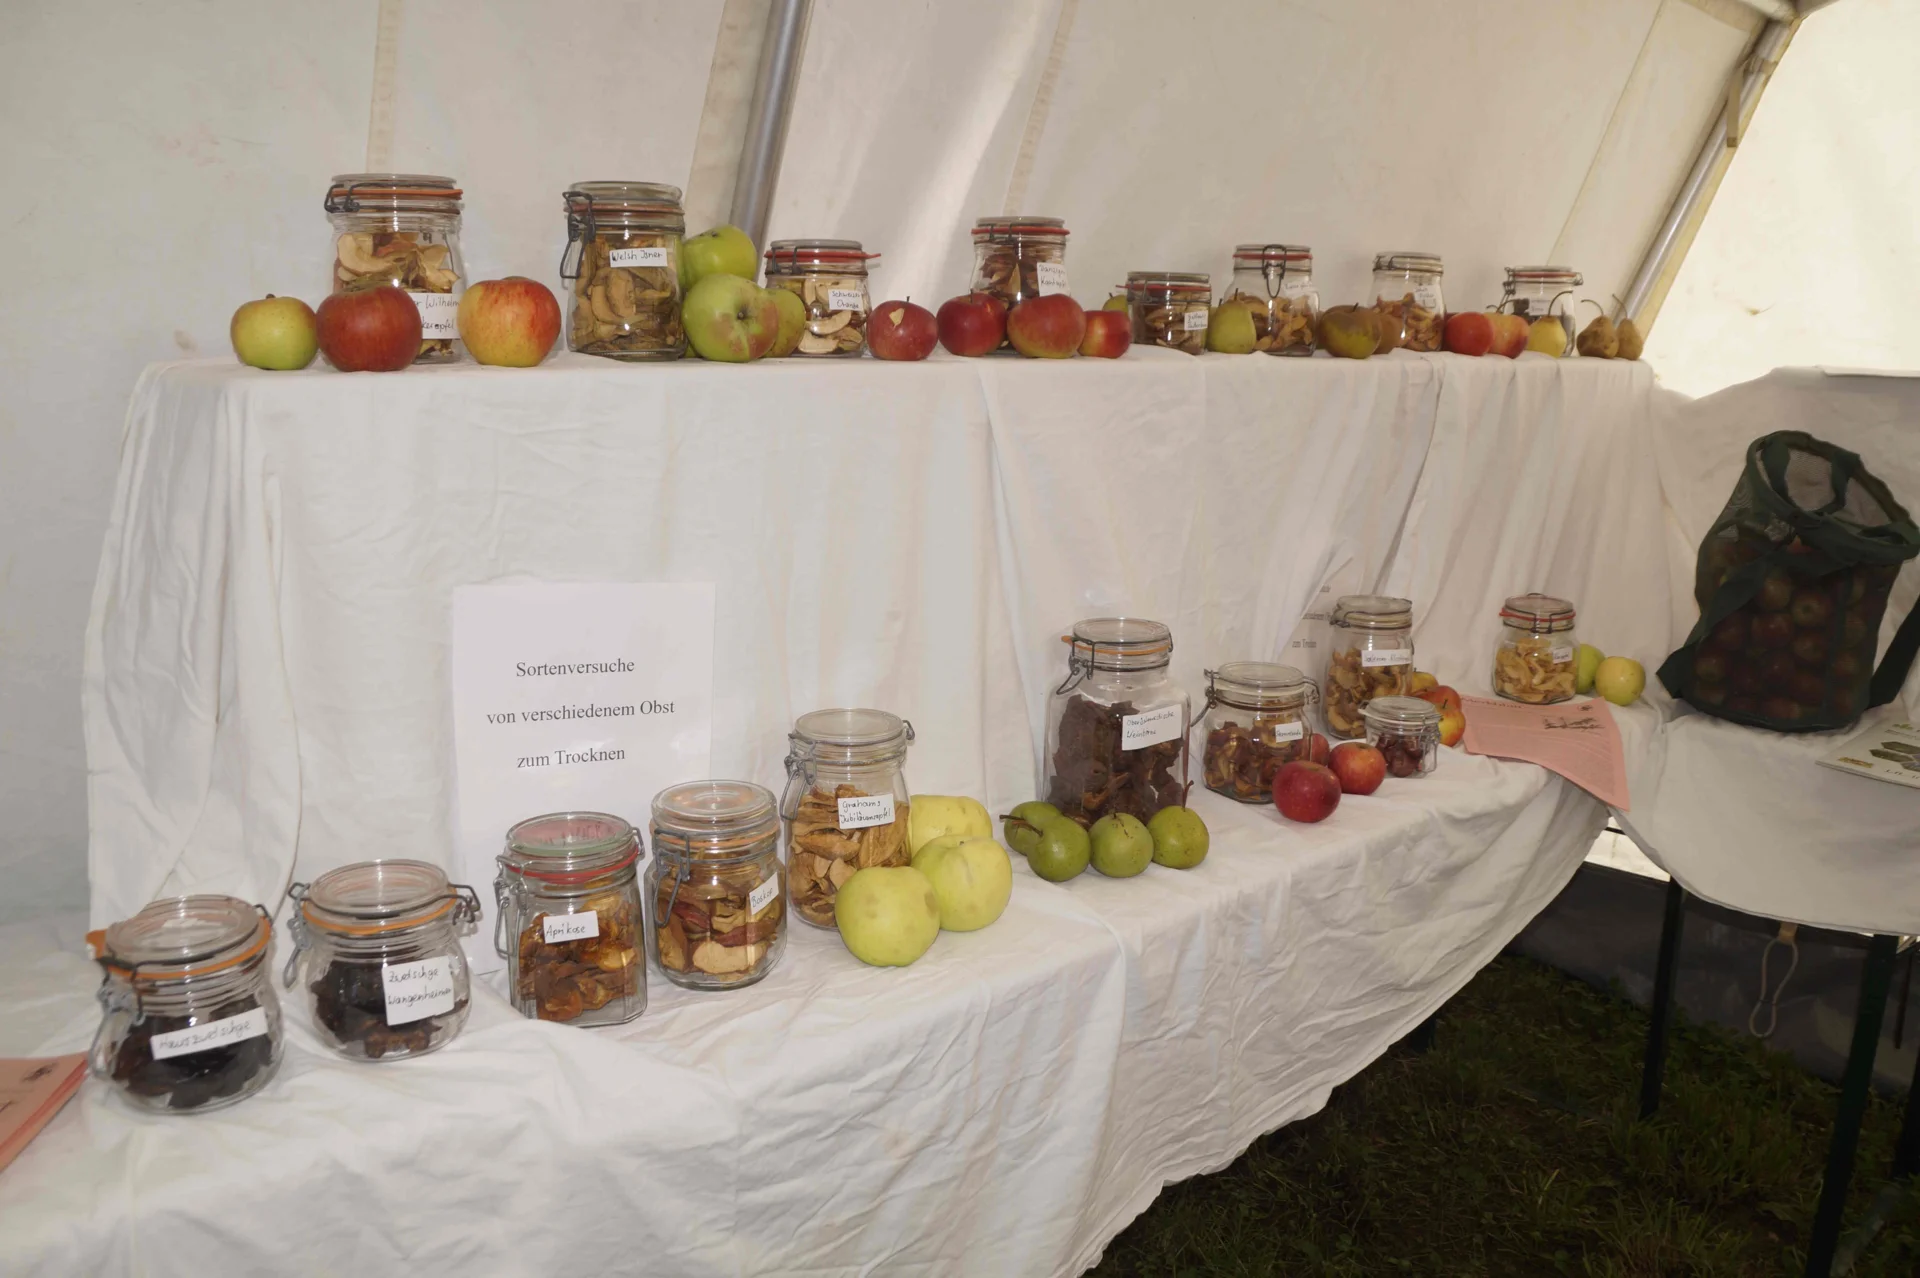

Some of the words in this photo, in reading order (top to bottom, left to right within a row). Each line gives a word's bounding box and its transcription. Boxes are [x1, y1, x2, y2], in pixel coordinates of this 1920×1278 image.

[516, 658, 635, 677] Sortenversuche
[486, 712, 516, 724] von
[521, 703, 635, 722] verschiedenem
[640, 700, 675, 715] Obst
[517, 755, 550, 768] zum
[554, 747, 625, 765] Trocknen
[842, 800, 881, 813] Grahams
[751, 887, 773, 908] Boskop
[545, 922, 586, 940] Aprikose
